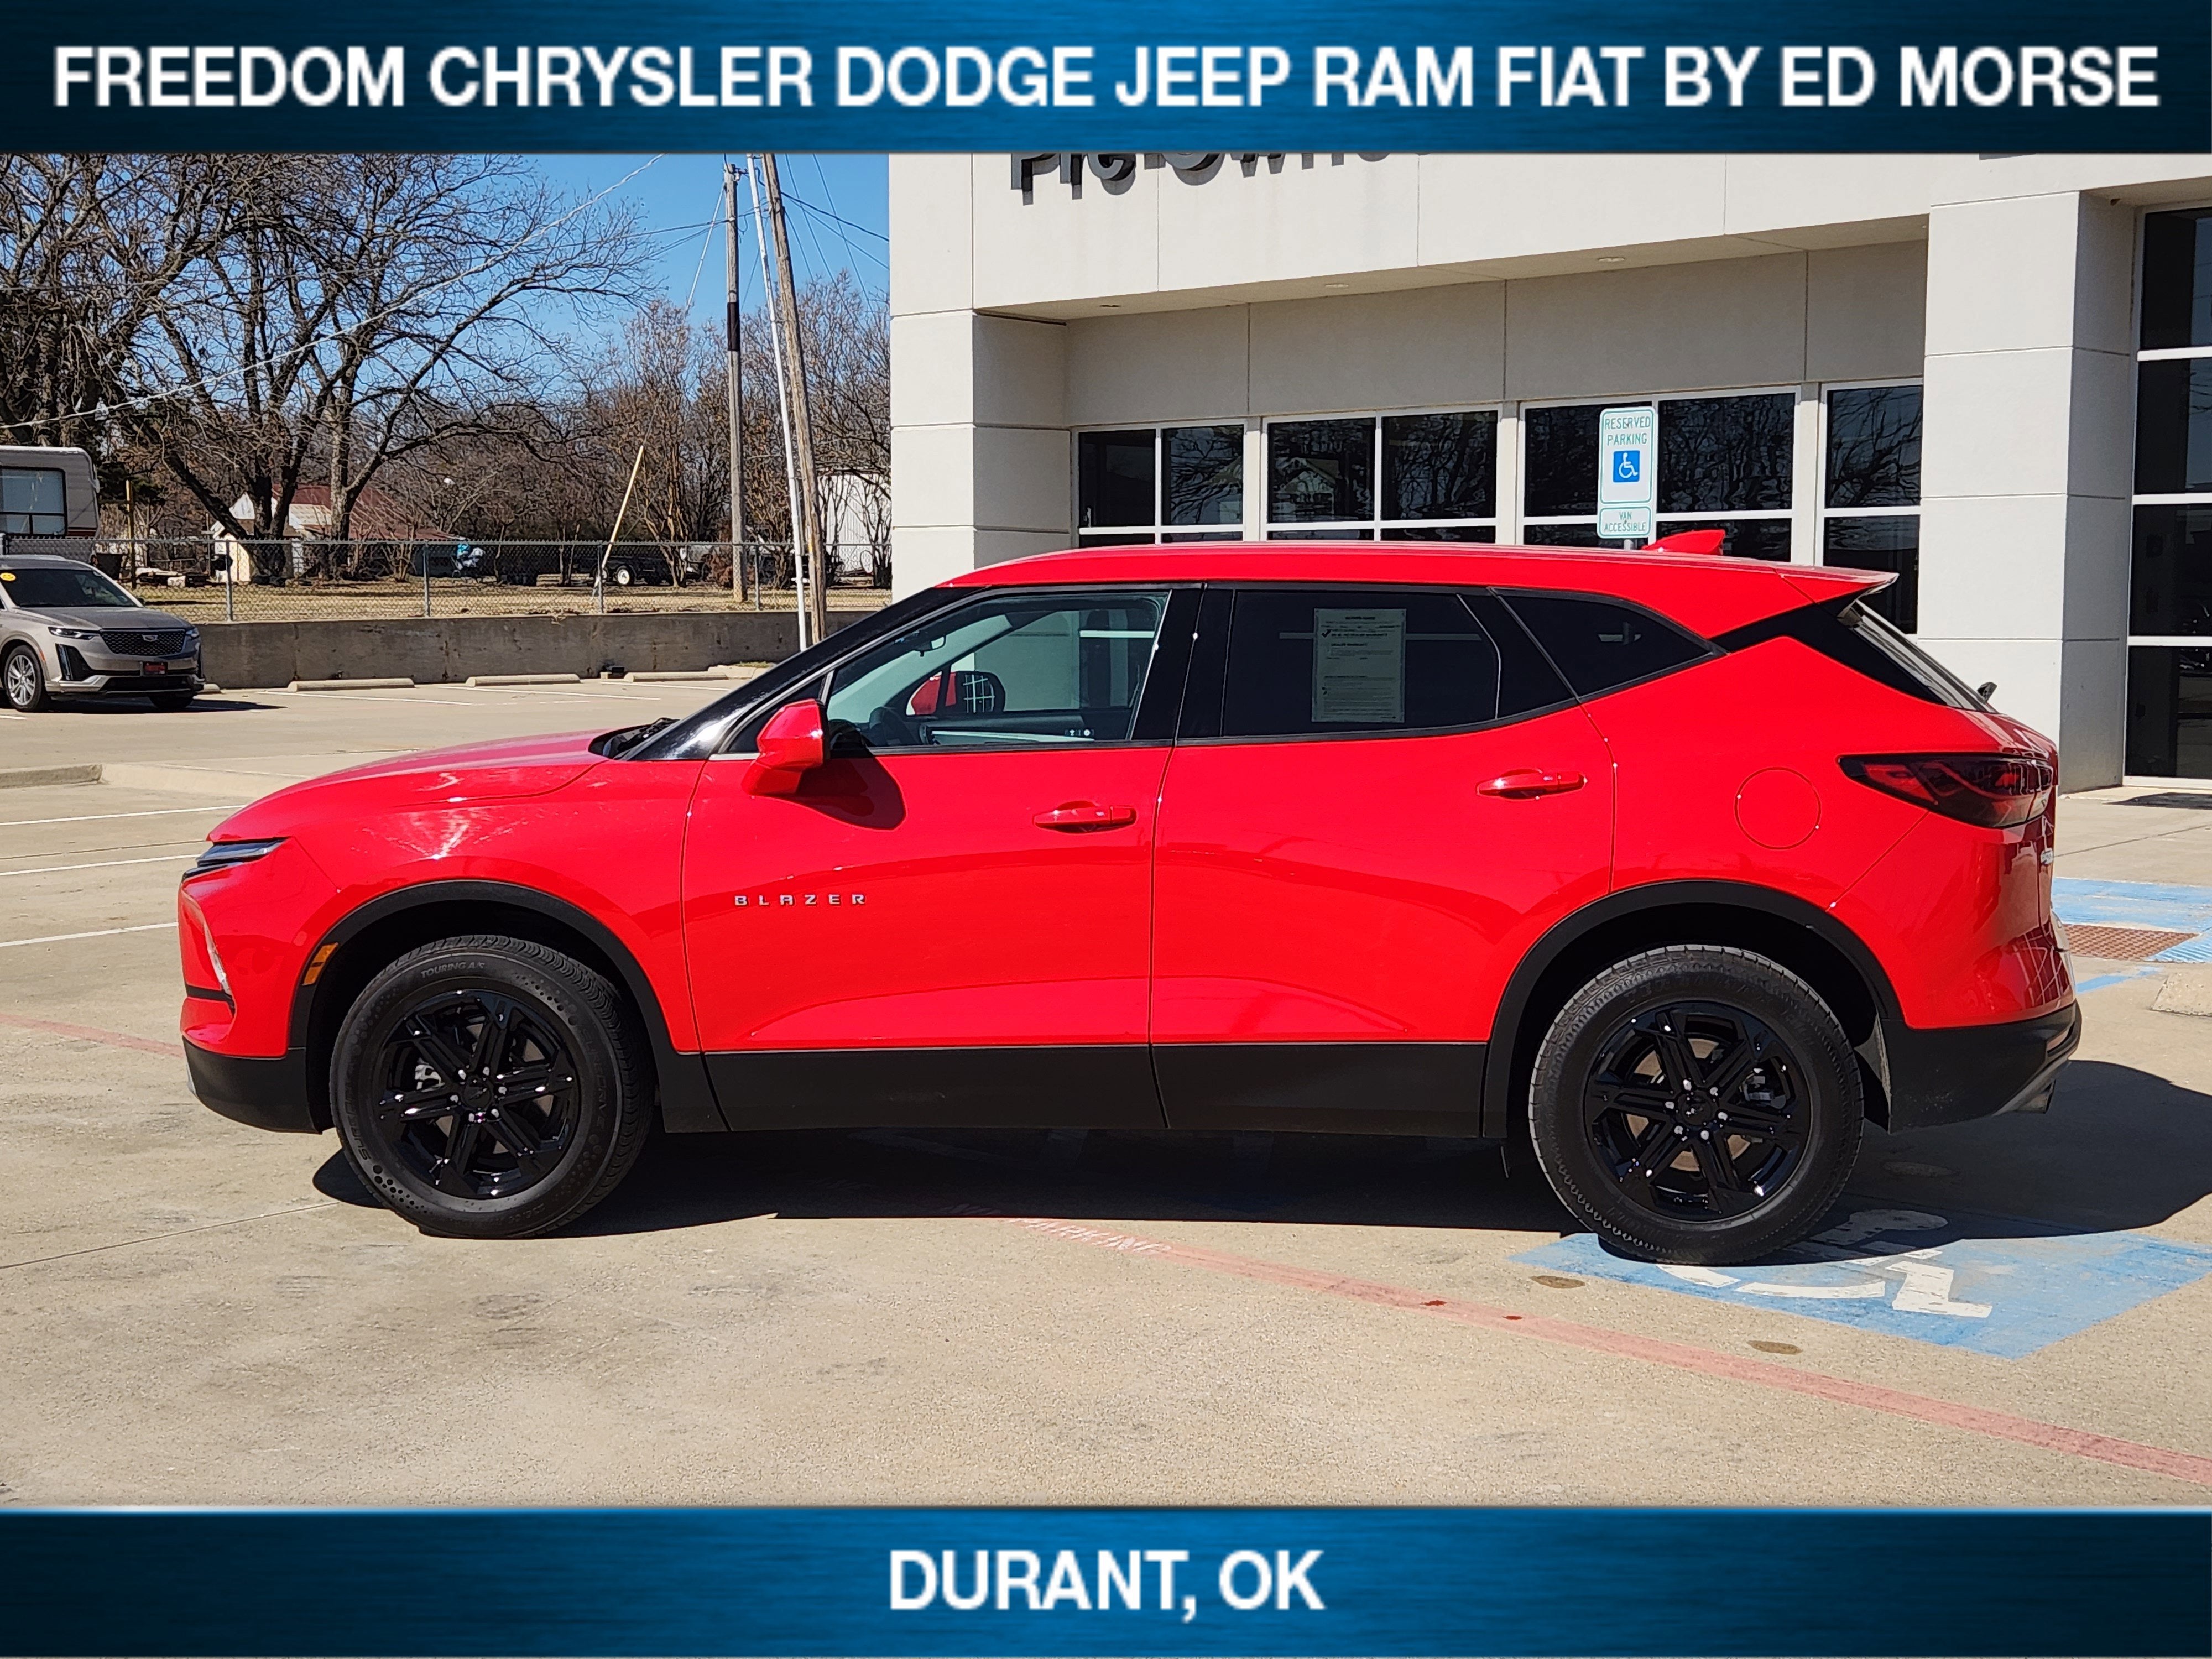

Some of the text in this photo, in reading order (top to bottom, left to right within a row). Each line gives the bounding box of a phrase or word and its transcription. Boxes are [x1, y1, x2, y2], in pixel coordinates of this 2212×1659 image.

[1605, 416, 1651, 430] RESERVED
[1606, 433, 1647, 446] PARKING
[1619, 511, 1632, 520] VAN
[1604, 522, 1646, 532] ACCESSIBLE
[734, 894, 866, 906] BLAZER
[420, 961, 467, 979] TOURING
